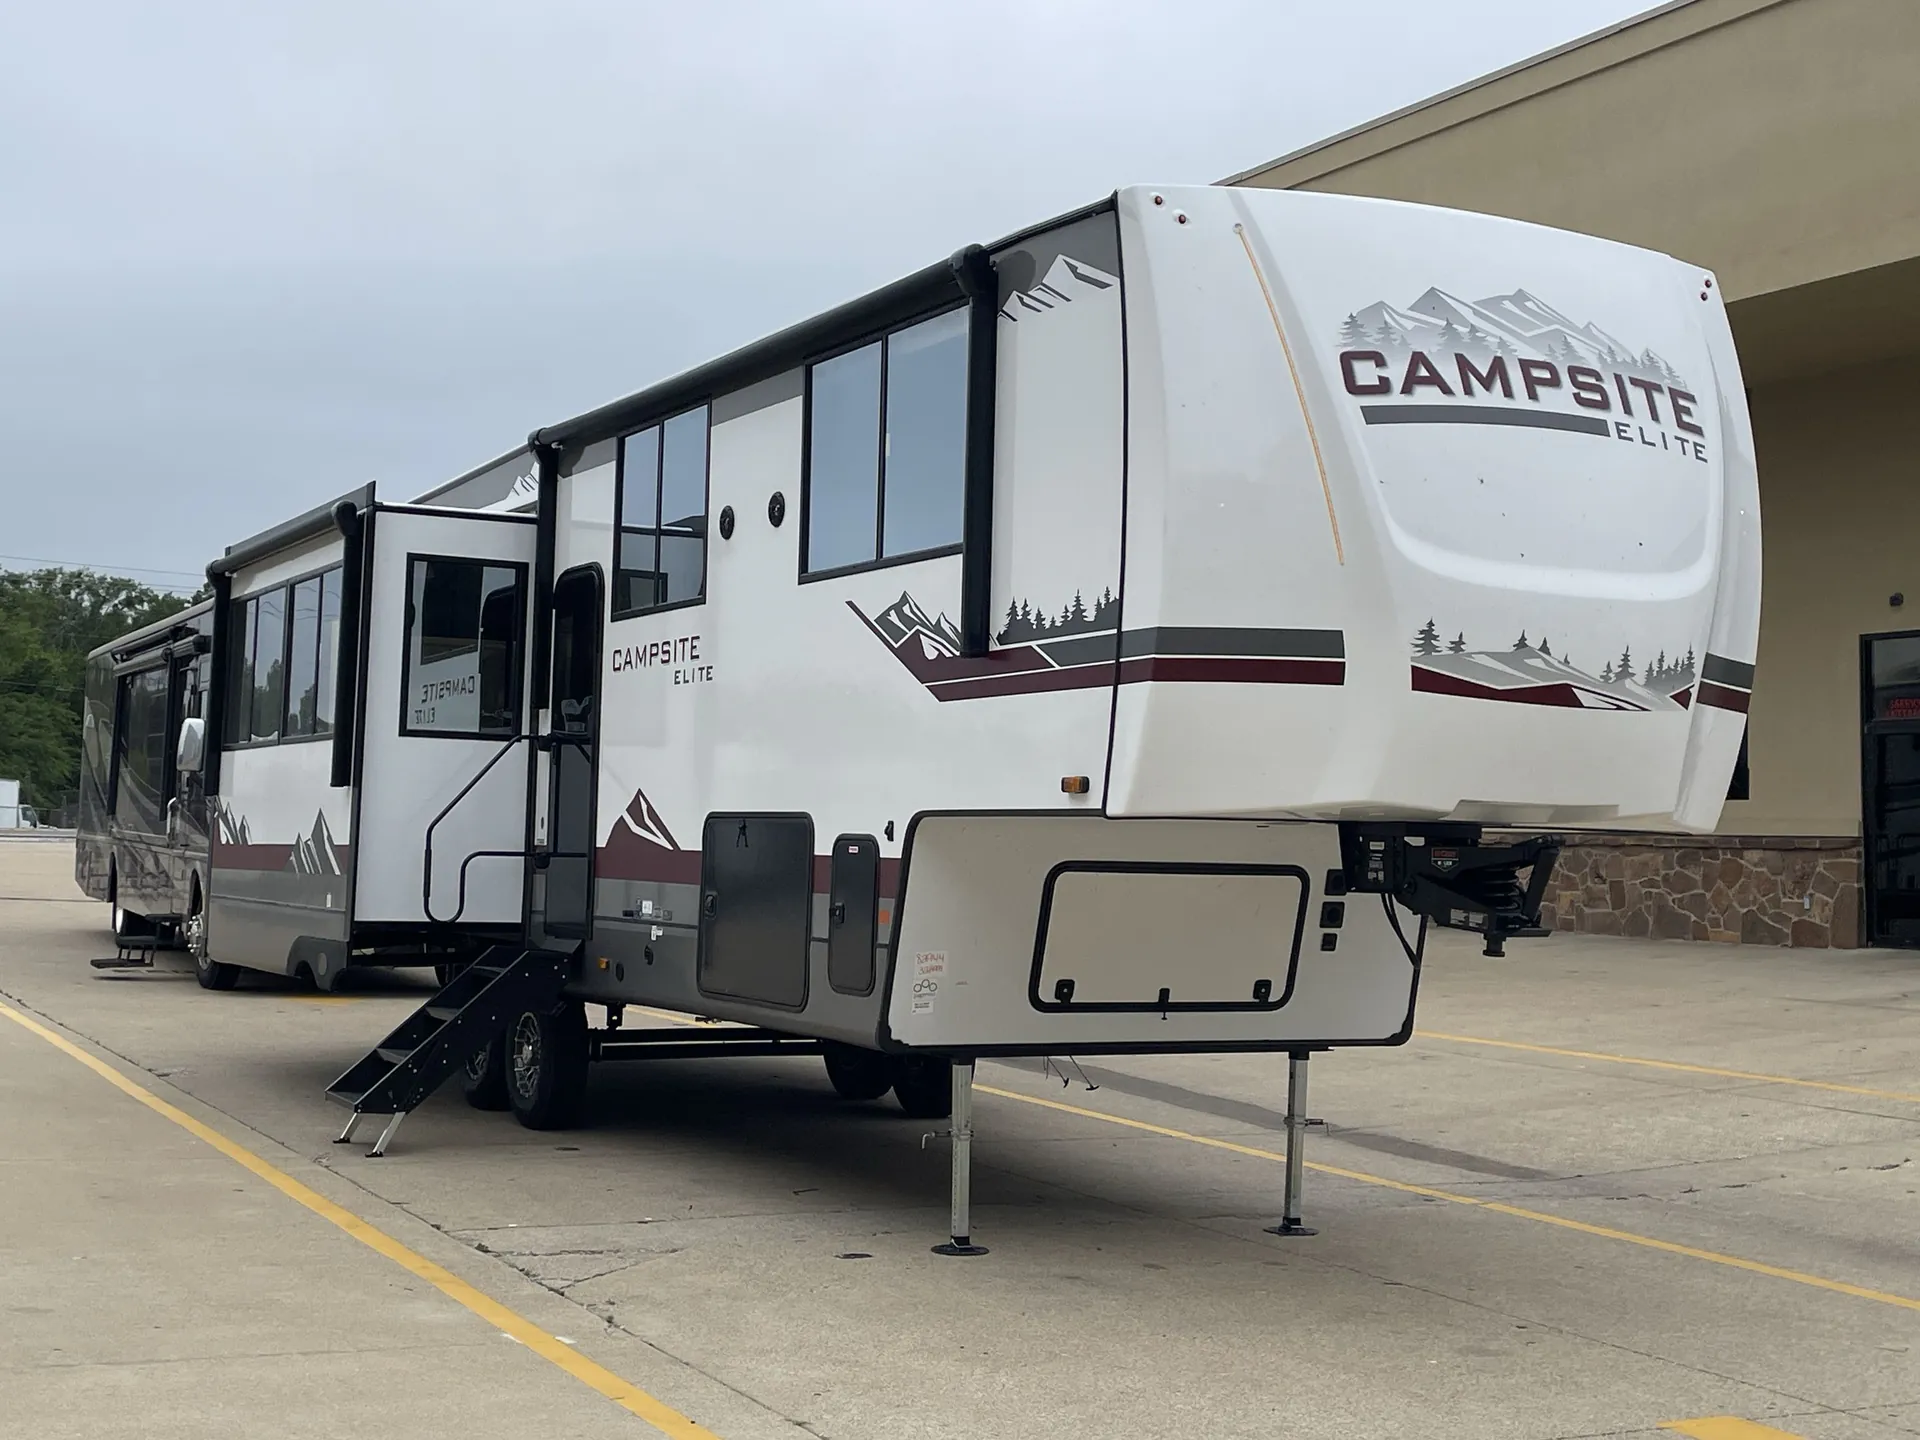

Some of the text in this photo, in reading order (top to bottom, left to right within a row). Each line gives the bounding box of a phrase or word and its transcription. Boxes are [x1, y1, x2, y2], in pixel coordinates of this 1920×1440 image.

[1339, 350, 1705, 438] CAMPSITE
[1614, 421, 1708, 463] ELITE
[612, 635, 700, 672] CAMPSITE
[674, 665, 713, 685] ELITE
